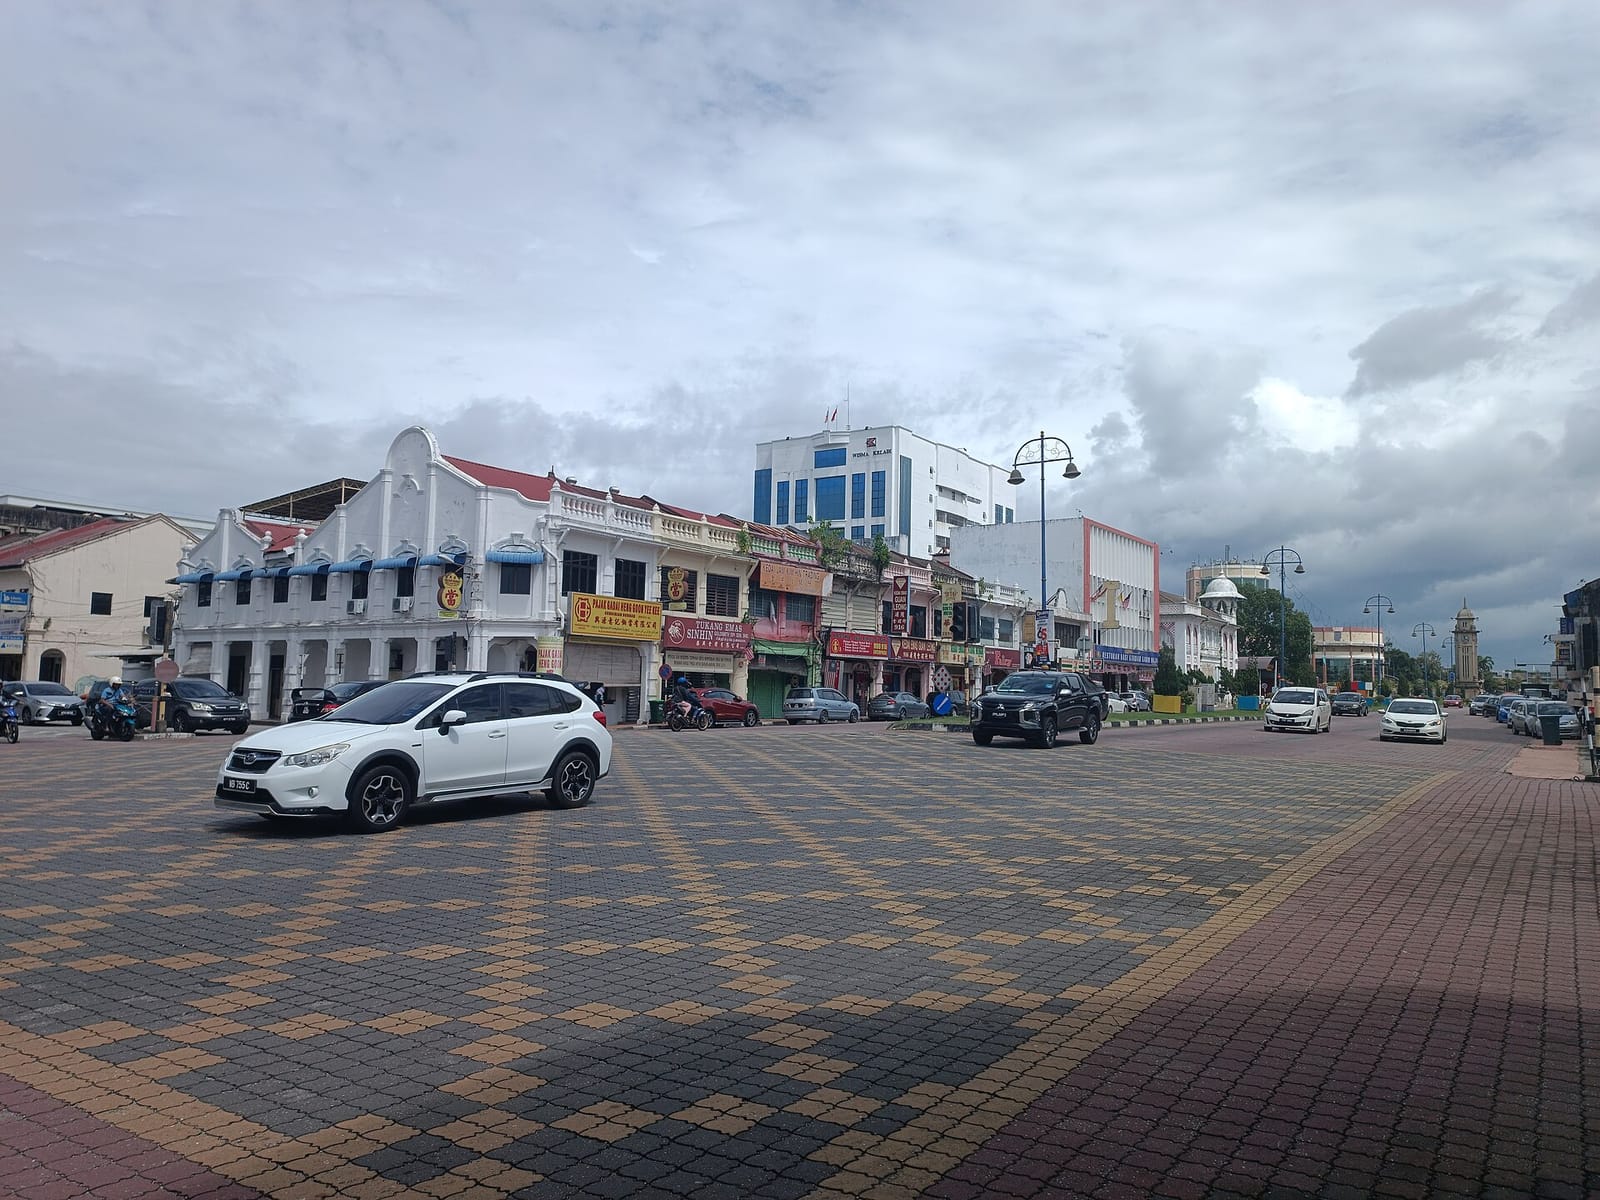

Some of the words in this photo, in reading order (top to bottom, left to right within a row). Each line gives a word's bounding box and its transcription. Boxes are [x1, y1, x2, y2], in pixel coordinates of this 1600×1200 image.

[592, 598, 606, 609] PAJAK
[607, 600, 620, 611] GADAI
[621, 602, 632, 612] HENG
[652, 606, 660, 615] KEE
[696, 621, 723, 631] TUKANG
[726, 623, 743, 633] EMAS
[687, 629, 714, 640] SINHIN
